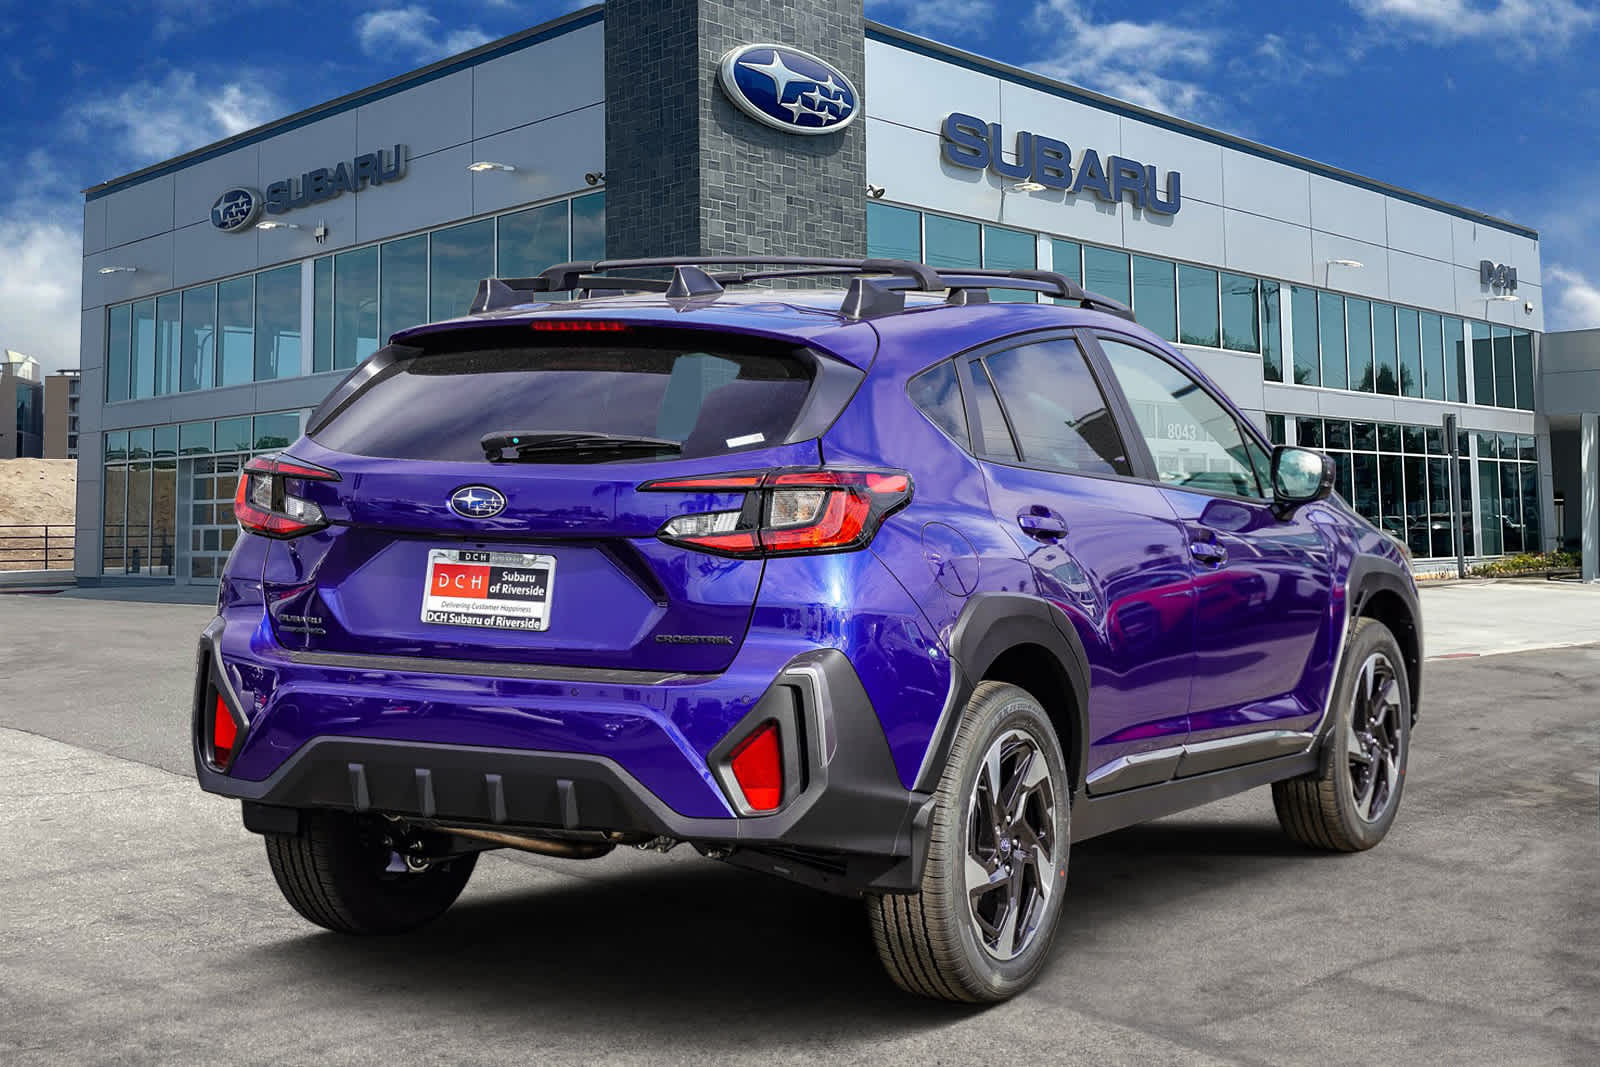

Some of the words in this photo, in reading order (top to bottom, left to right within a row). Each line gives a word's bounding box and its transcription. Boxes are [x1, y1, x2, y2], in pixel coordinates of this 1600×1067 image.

[941, 112, 1181, 215] SUBARU
[266, 144, 406, 215] SUBARU
[1167, 423, 1197, 440] 8043
[465, 553, 487, 561] DCH
[438, 573, 482, 589] DCH
[502, 571, 536, 583] Subaru
[489, 583, 500, 593] of
[501, 584, 545, 596] Riverside
[427, 612, 448, 623] DCH
[448, 613, 483, 625] Subaru
[484, 615, 496, 625] of
[496, 616, 540, 629] Riverside
